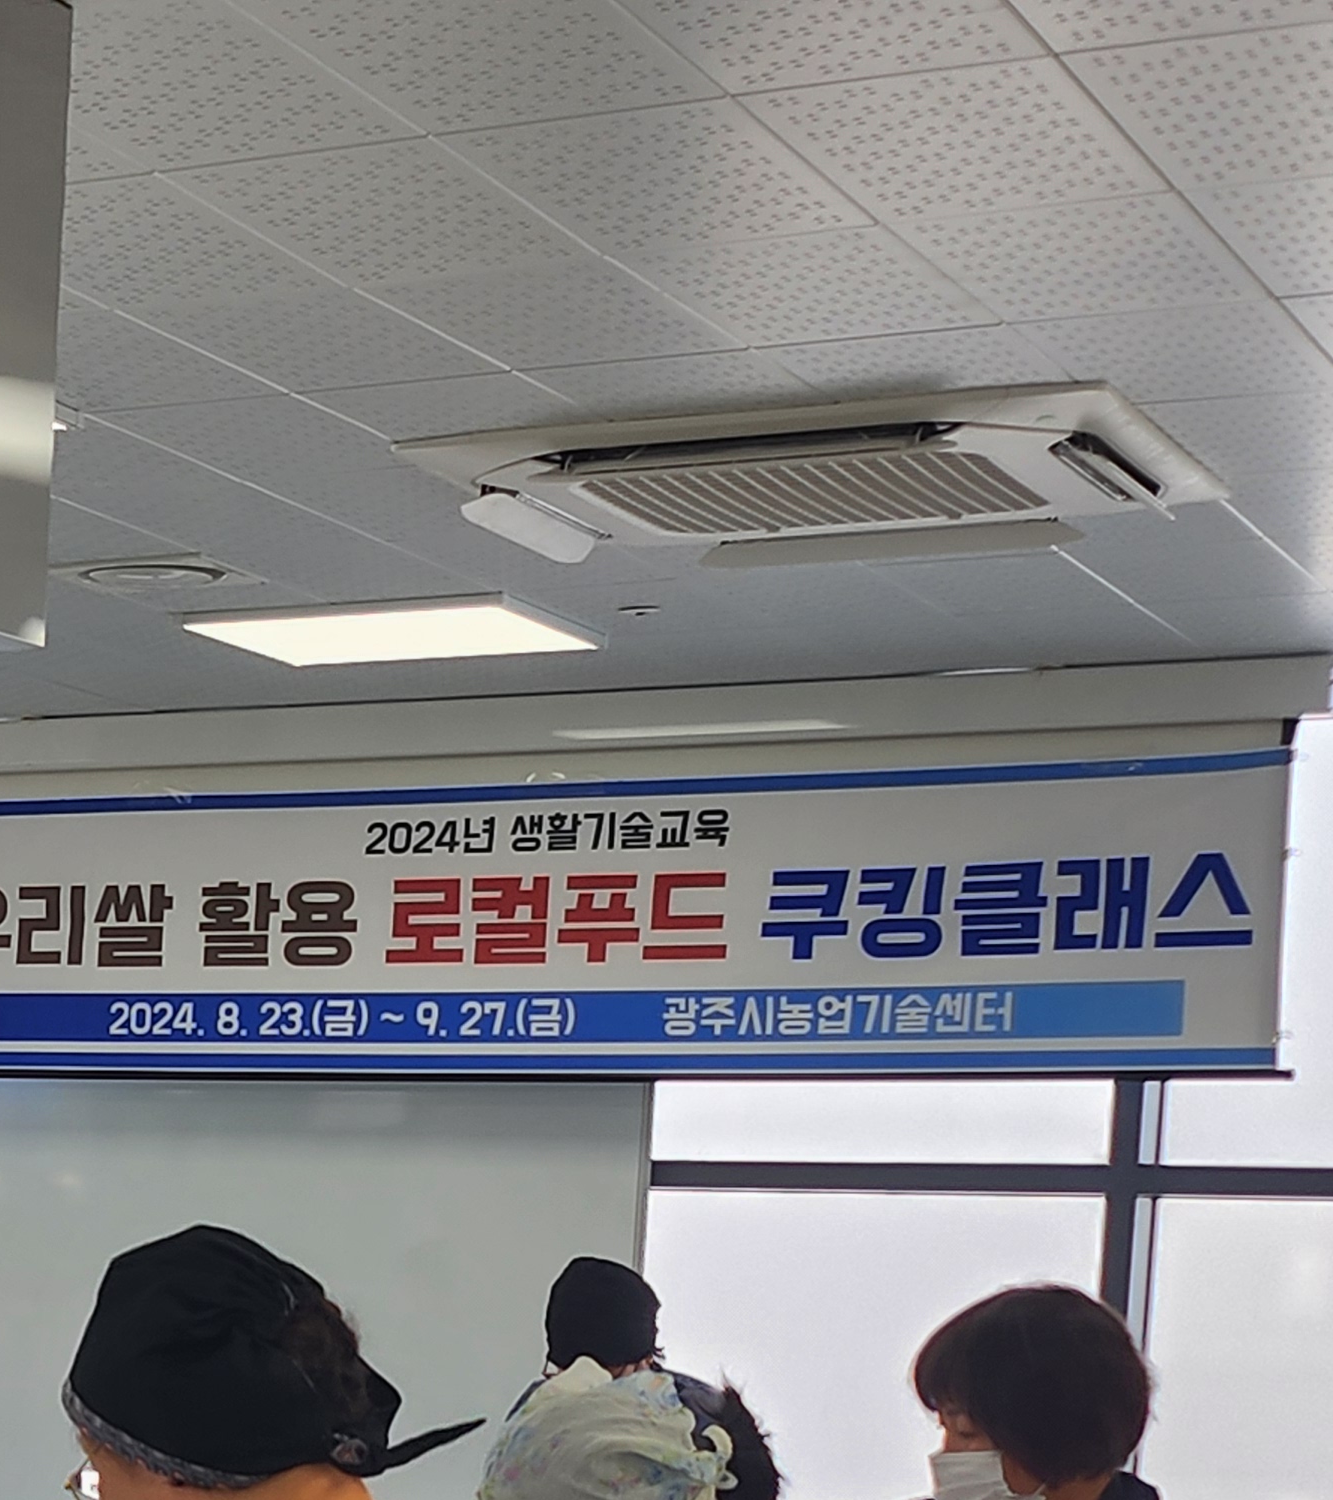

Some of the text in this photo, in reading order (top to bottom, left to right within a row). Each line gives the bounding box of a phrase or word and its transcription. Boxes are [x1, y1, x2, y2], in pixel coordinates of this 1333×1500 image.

[364, 808, 731, 856] 2024년 생활기술교육
[198, 880, 359, 968] 활용
[384, 871, 729, 965] 로컬푸드
[759, 851, 1254, 962] 쿠킹클래스
[107, 1001, 206, 1037] 2024.
[216, 1001, 248, 1036] 8.
[258, 999, 369, 1037] 23.(금)
[415, 1001, 448, 1037] 9.
[458, 997, 577, 1037] 27.(금)
[661, 991, 1015, 1037] 광주시농업기술센터
